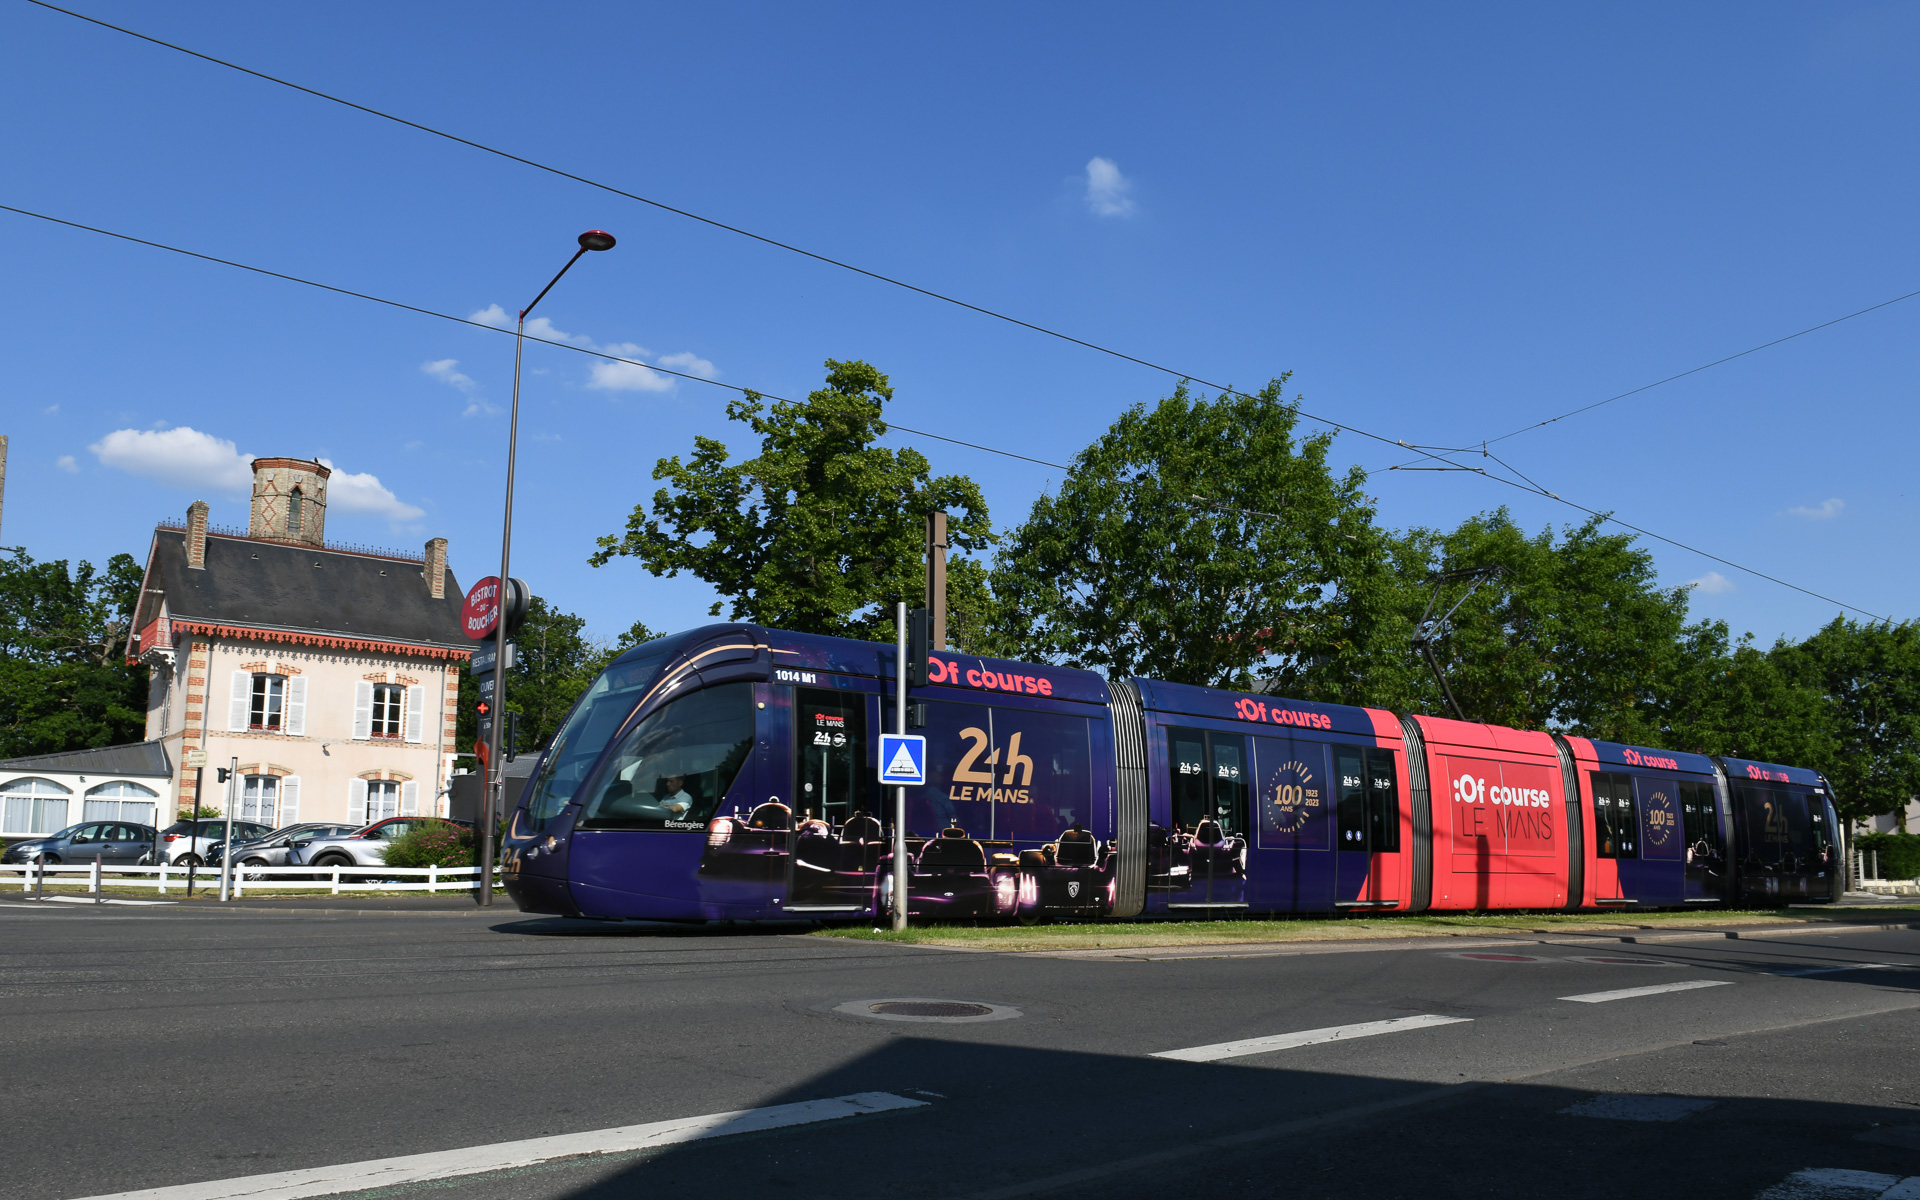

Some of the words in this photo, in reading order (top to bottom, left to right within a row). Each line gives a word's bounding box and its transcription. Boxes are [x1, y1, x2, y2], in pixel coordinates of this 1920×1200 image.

[471, 585, 497, 607] BISTROT
[468, 605, 498, 630] BOUCHER
[472, 652, 496, 668] RESTAURAN
[775, 670, 800, 682] 1014
[801, 672, 816, 684] M1
[966, 669, 1053, 696] course
[480, 680, 494, 693] OUVE
[1234, 698, 1267, 722] :Of
[1271, 708, 1332, 729] course
[816, 719, 825, 727] LE
[826, 720, 845, 728] MANS
[814, 731, 831, 743] 24h
[952, 727, 1033, 786] 24h
[1643, 755, 1678, 770] course
[949, 785, 974, 801] LE
[975, 787, 1029, 804] MANS
[1274, 784, 1302, 806] 100
[1305, 789, 1318, 798] 1923
[1453, 774, 1485, 804] :Of
[1490, 785, 1550, 808] course
[1280, 805, 1293, 813] ANS
[1305, 798, 1319, 807] 2023
[664, 819, 705, 831] Bérengère
[1462, 806, 1487, 837] LE
[1496, 809, 1552, 840] MANS
[1649, 809, 1665, 825] 100
